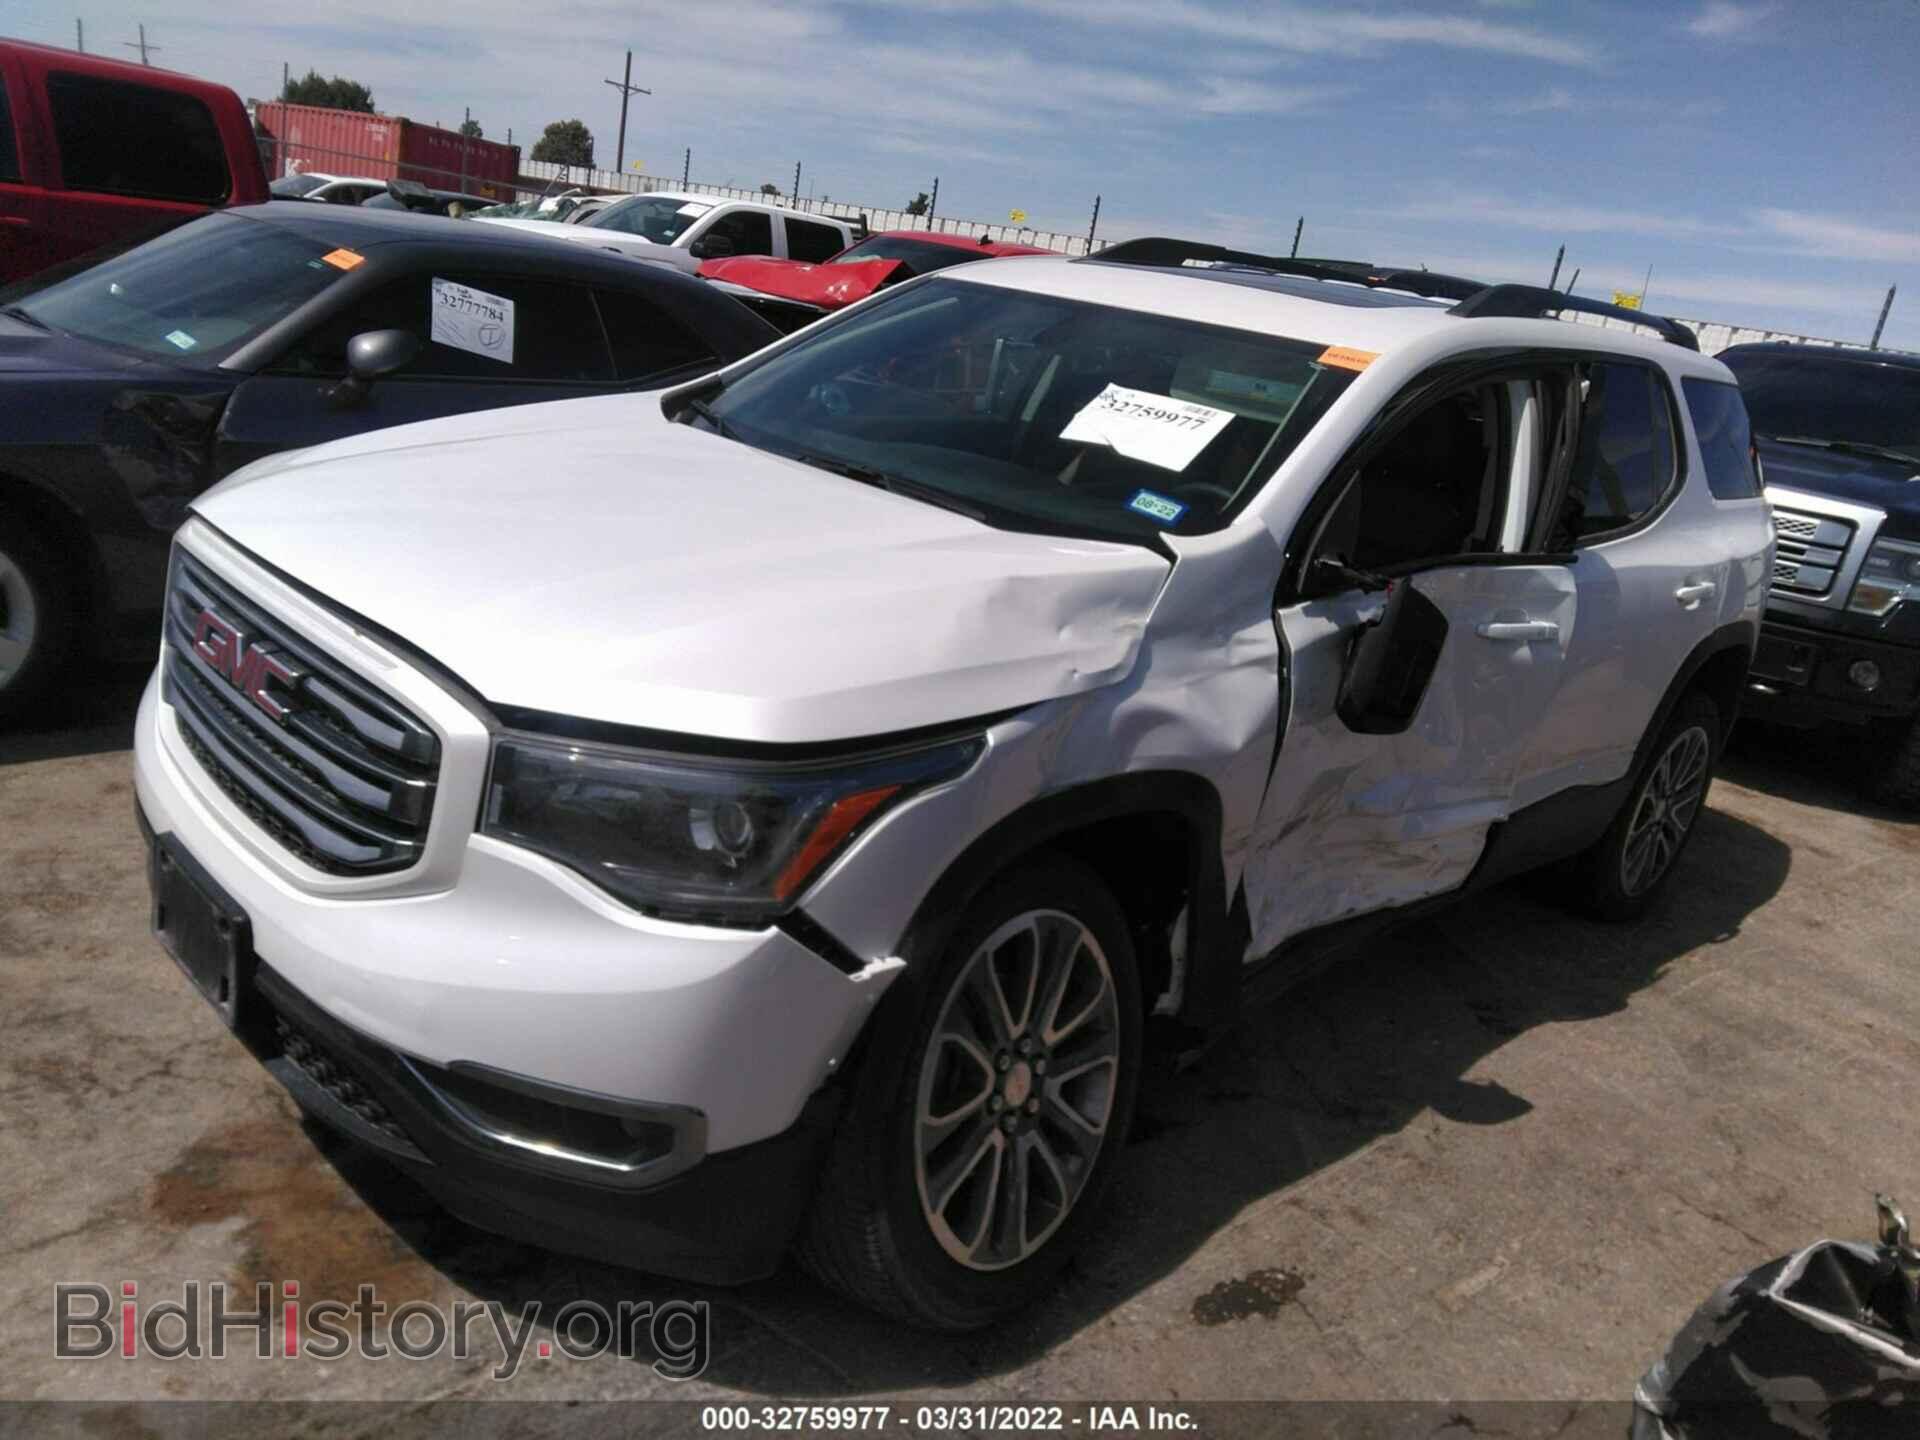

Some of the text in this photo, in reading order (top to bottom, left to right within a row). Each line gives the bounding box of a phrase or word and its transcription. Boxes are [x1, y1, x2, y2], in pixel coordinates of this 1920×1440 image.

[439, 292, 505, 323] 32777784
[1100, 399, 1206, 430] 32759977
[192, 607, 304, 723] GMC
